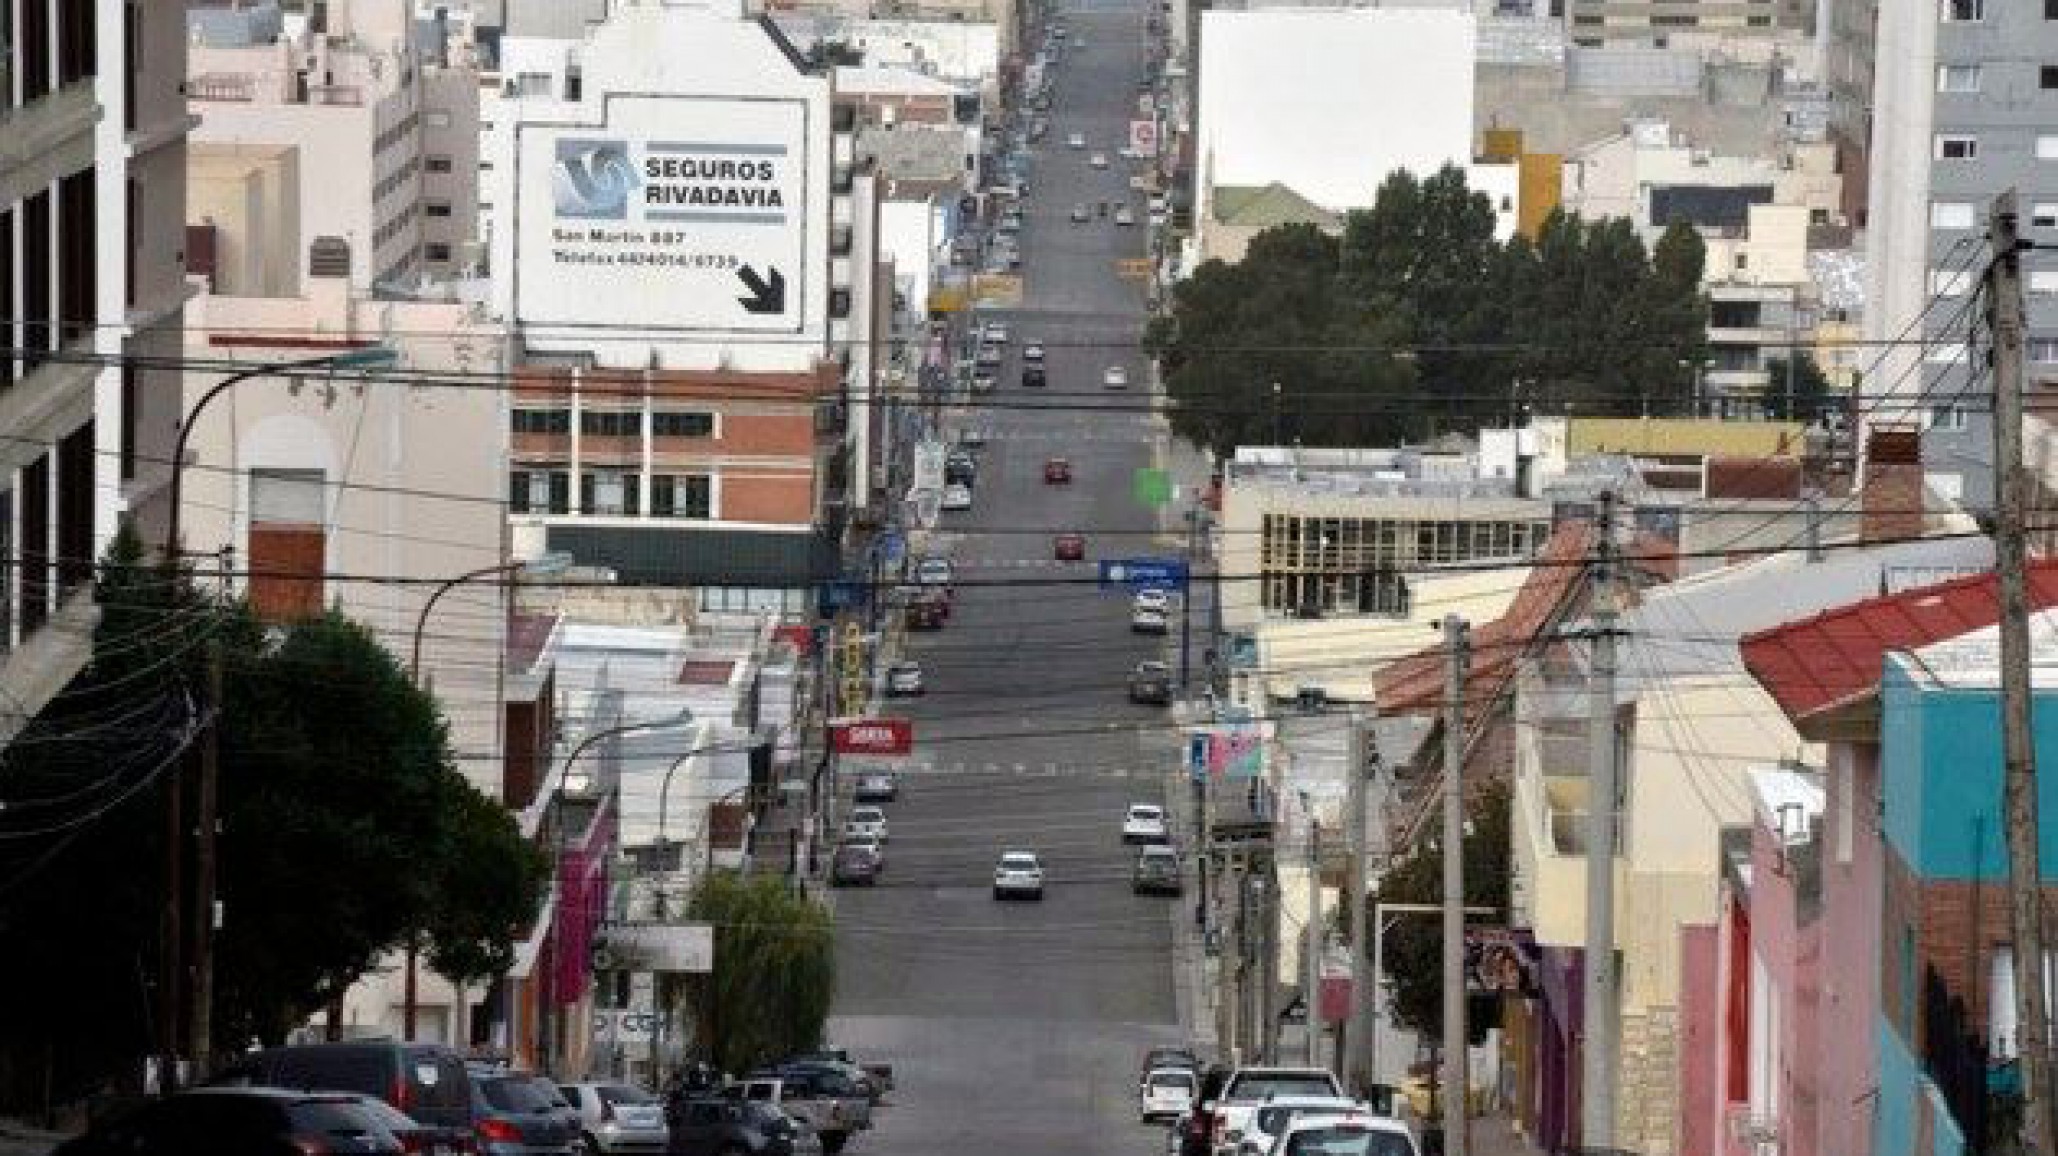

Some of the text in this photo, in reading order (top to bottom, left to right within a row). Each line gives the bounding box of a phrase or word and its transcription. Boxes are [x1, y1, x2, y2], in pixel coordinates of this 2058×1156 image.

[646, 157, 774, 181] SEGUROS
[645, 186, 783, 207] RIVADAVIA
[553, 229, 585, 242] San
